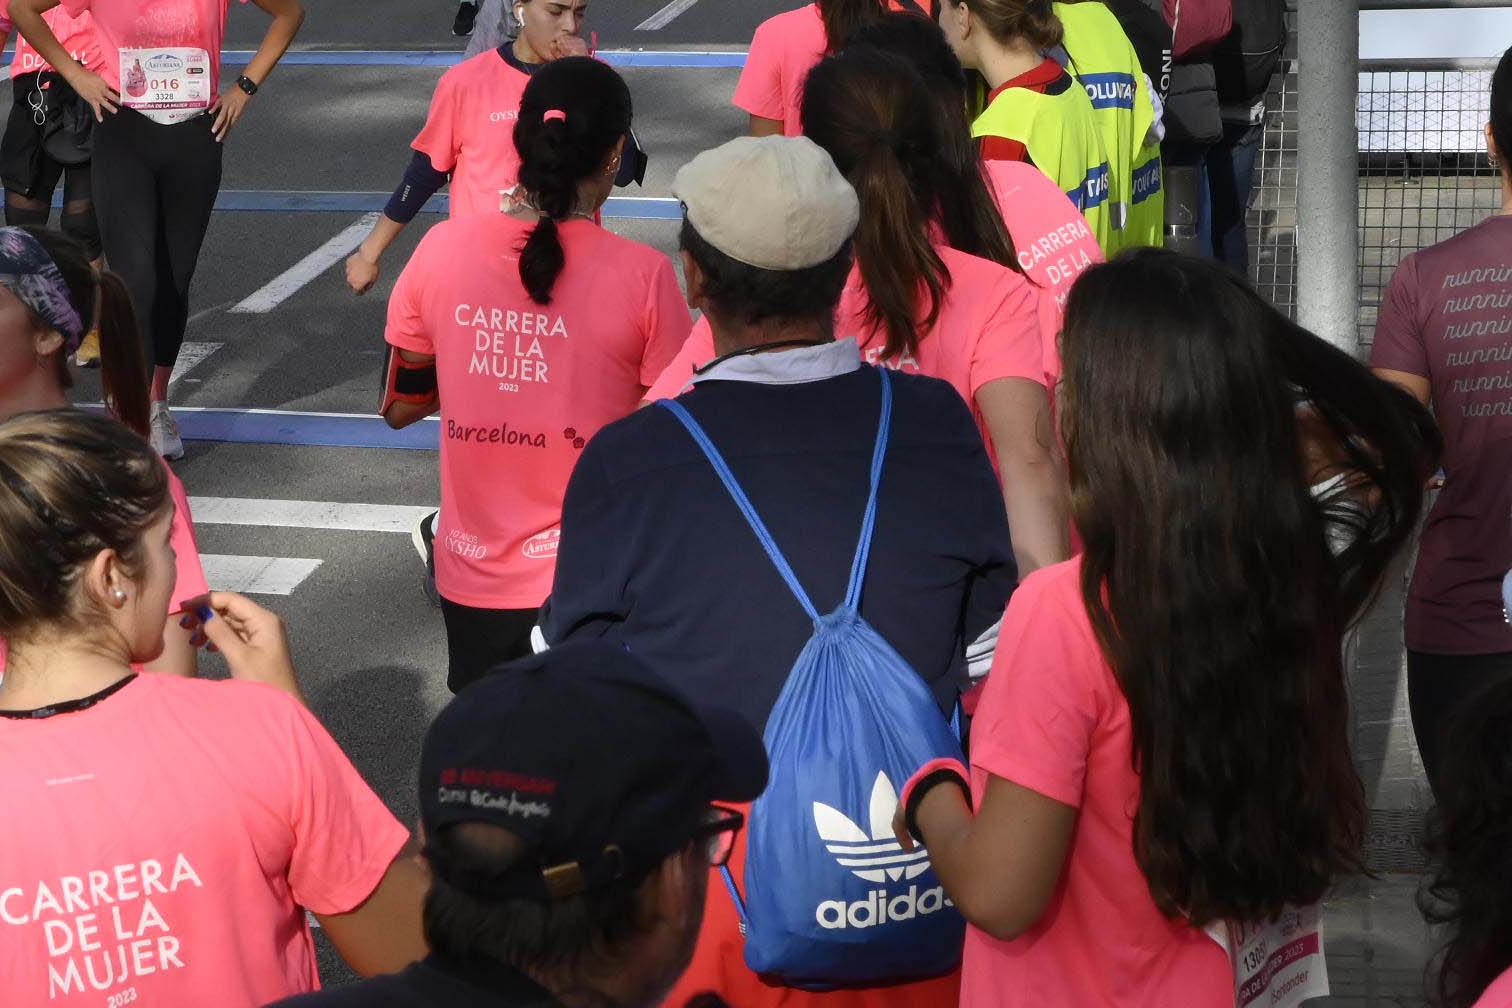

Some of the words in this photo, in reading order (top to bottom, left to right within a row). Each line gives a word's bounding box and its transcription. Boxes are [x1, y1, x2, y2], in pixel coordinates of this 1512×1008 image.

[150, 78, 180, 90] 016
[1017, 219, 1089, 270] CARRERA
[1046, 257, 1071, 286] DE
[1075, 248, 1091, 268] LA
[454, 303, 568, 338] CARRERA
[475, 329, 505, 354] DE
[515, 335, 545, 359] LA
[469, 352, 548, 384] MUJER
[498, 382, 519, 392] 2023
[447, 419, 546, 449] Barcelona
[43, 913, 102, 957] DE
[112, 898, 170, 941] LA
[48, 935, 186, 1000] MUJER
[107, 987, 138, 1008] 2023
